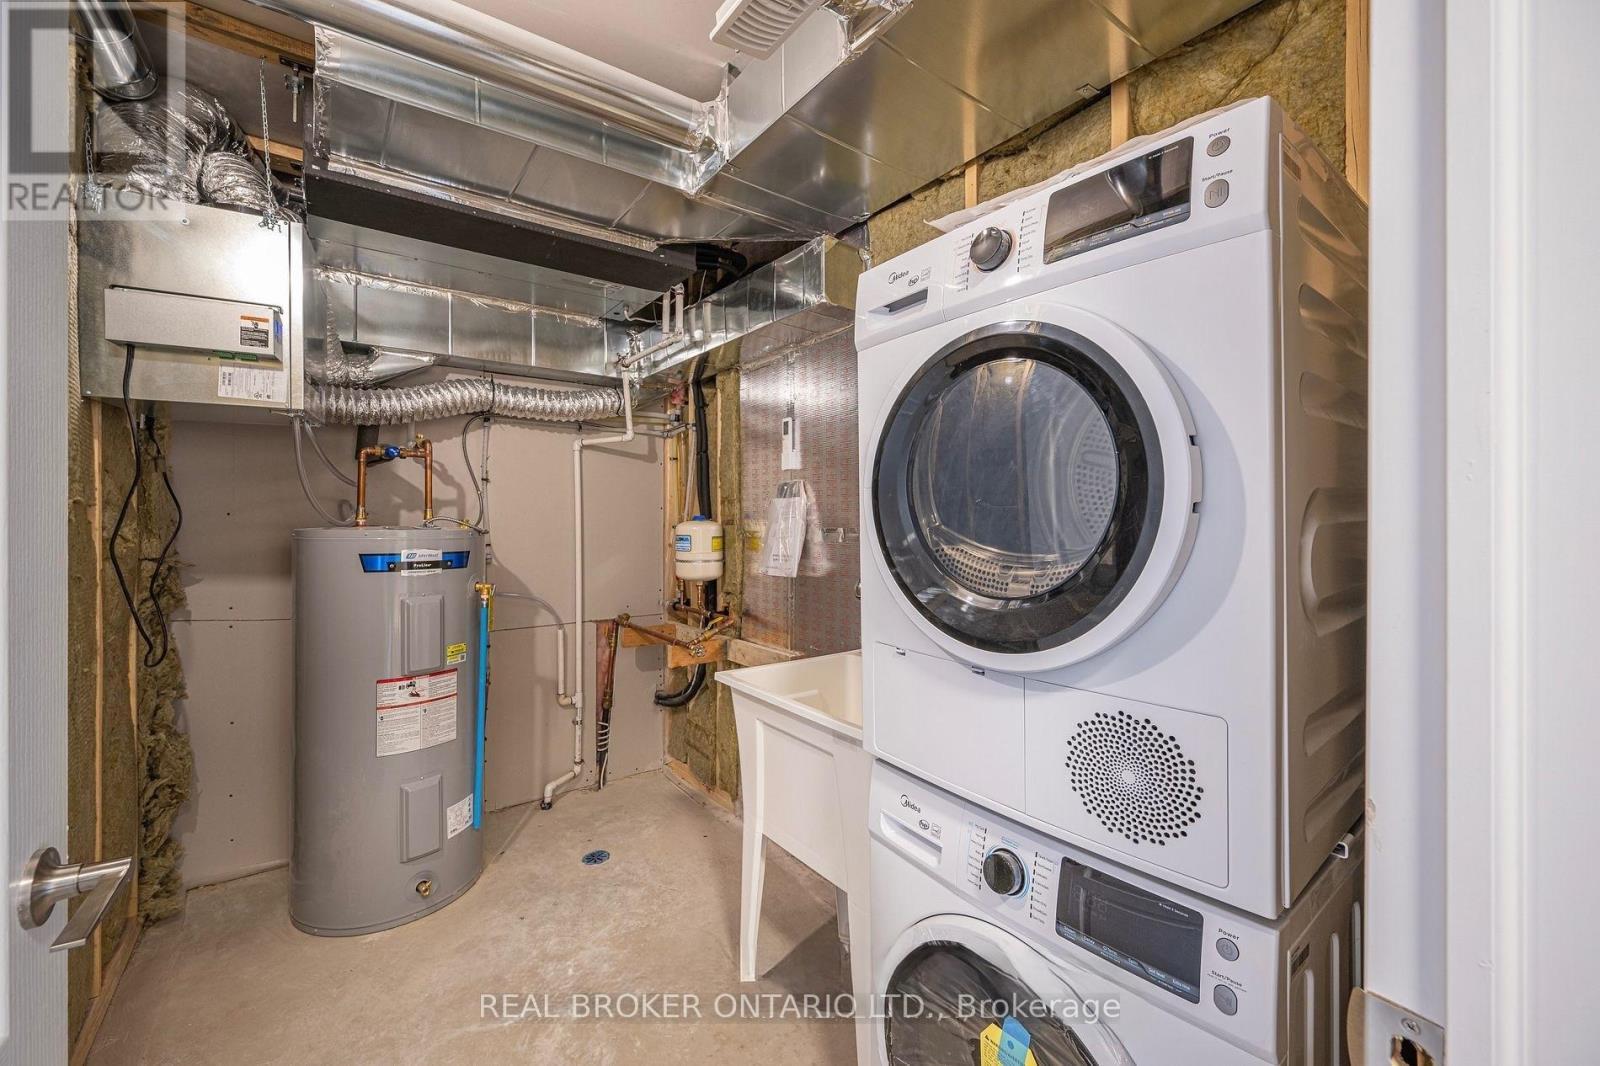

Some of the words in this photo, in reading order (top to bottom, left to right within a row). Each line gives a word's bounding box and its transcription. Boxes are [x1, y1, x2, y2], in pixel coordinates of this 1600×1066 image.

[1208, 127, 1231, 140] Power
[888, 270, 909, 285] Midea
[900, 794, 921, 814] Midea
[1218, 927, 1240, 941] Power
[1211, 970, 1243, 988] Start/Pause
